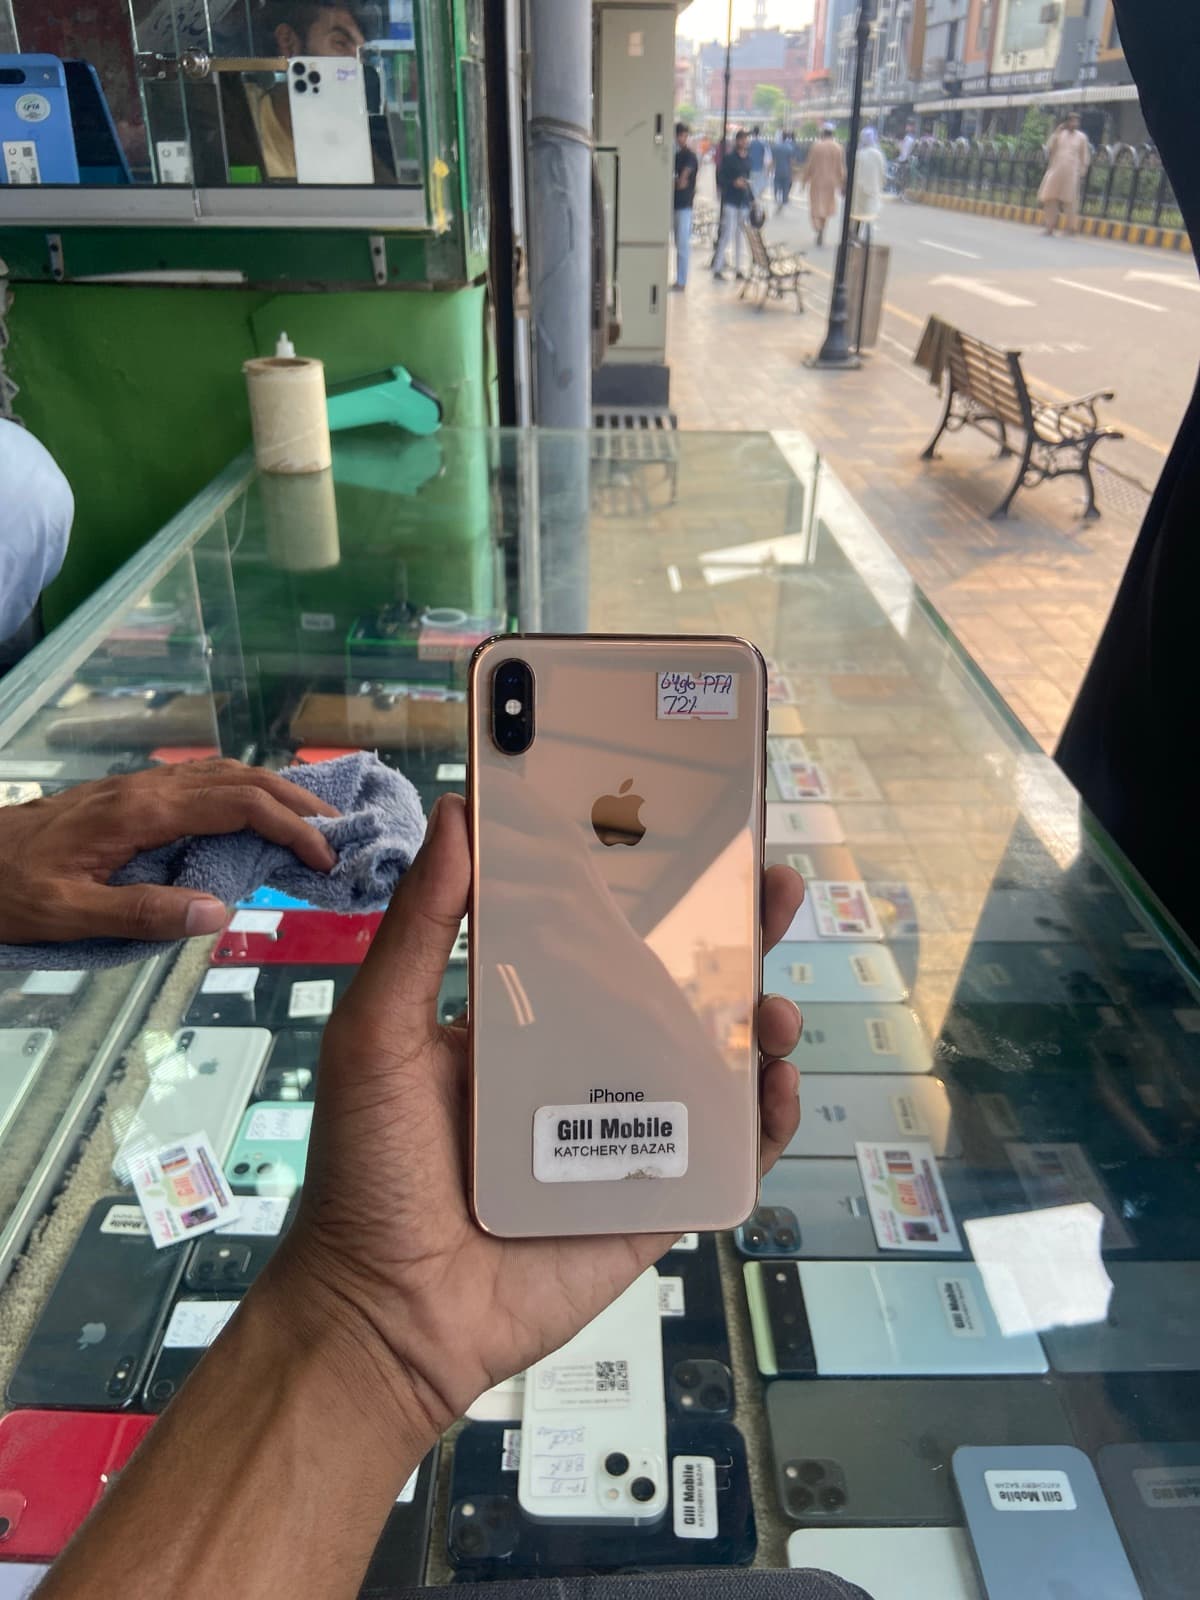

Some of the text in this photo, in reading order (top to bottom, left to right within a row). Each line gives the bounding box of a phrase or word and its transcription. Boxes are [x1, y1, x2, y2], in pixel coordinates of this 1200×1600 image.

[589, 1089, 645, 1103] iPhone
[557, 1117, 673, 1141] Gill Mobile
[554, 1143, 676, 1157] KATCHERY BAZAR
[682, 1464, 696, 1525] Gill Mobile
[999, 1491, 1063, 1502] Gill Mobile
